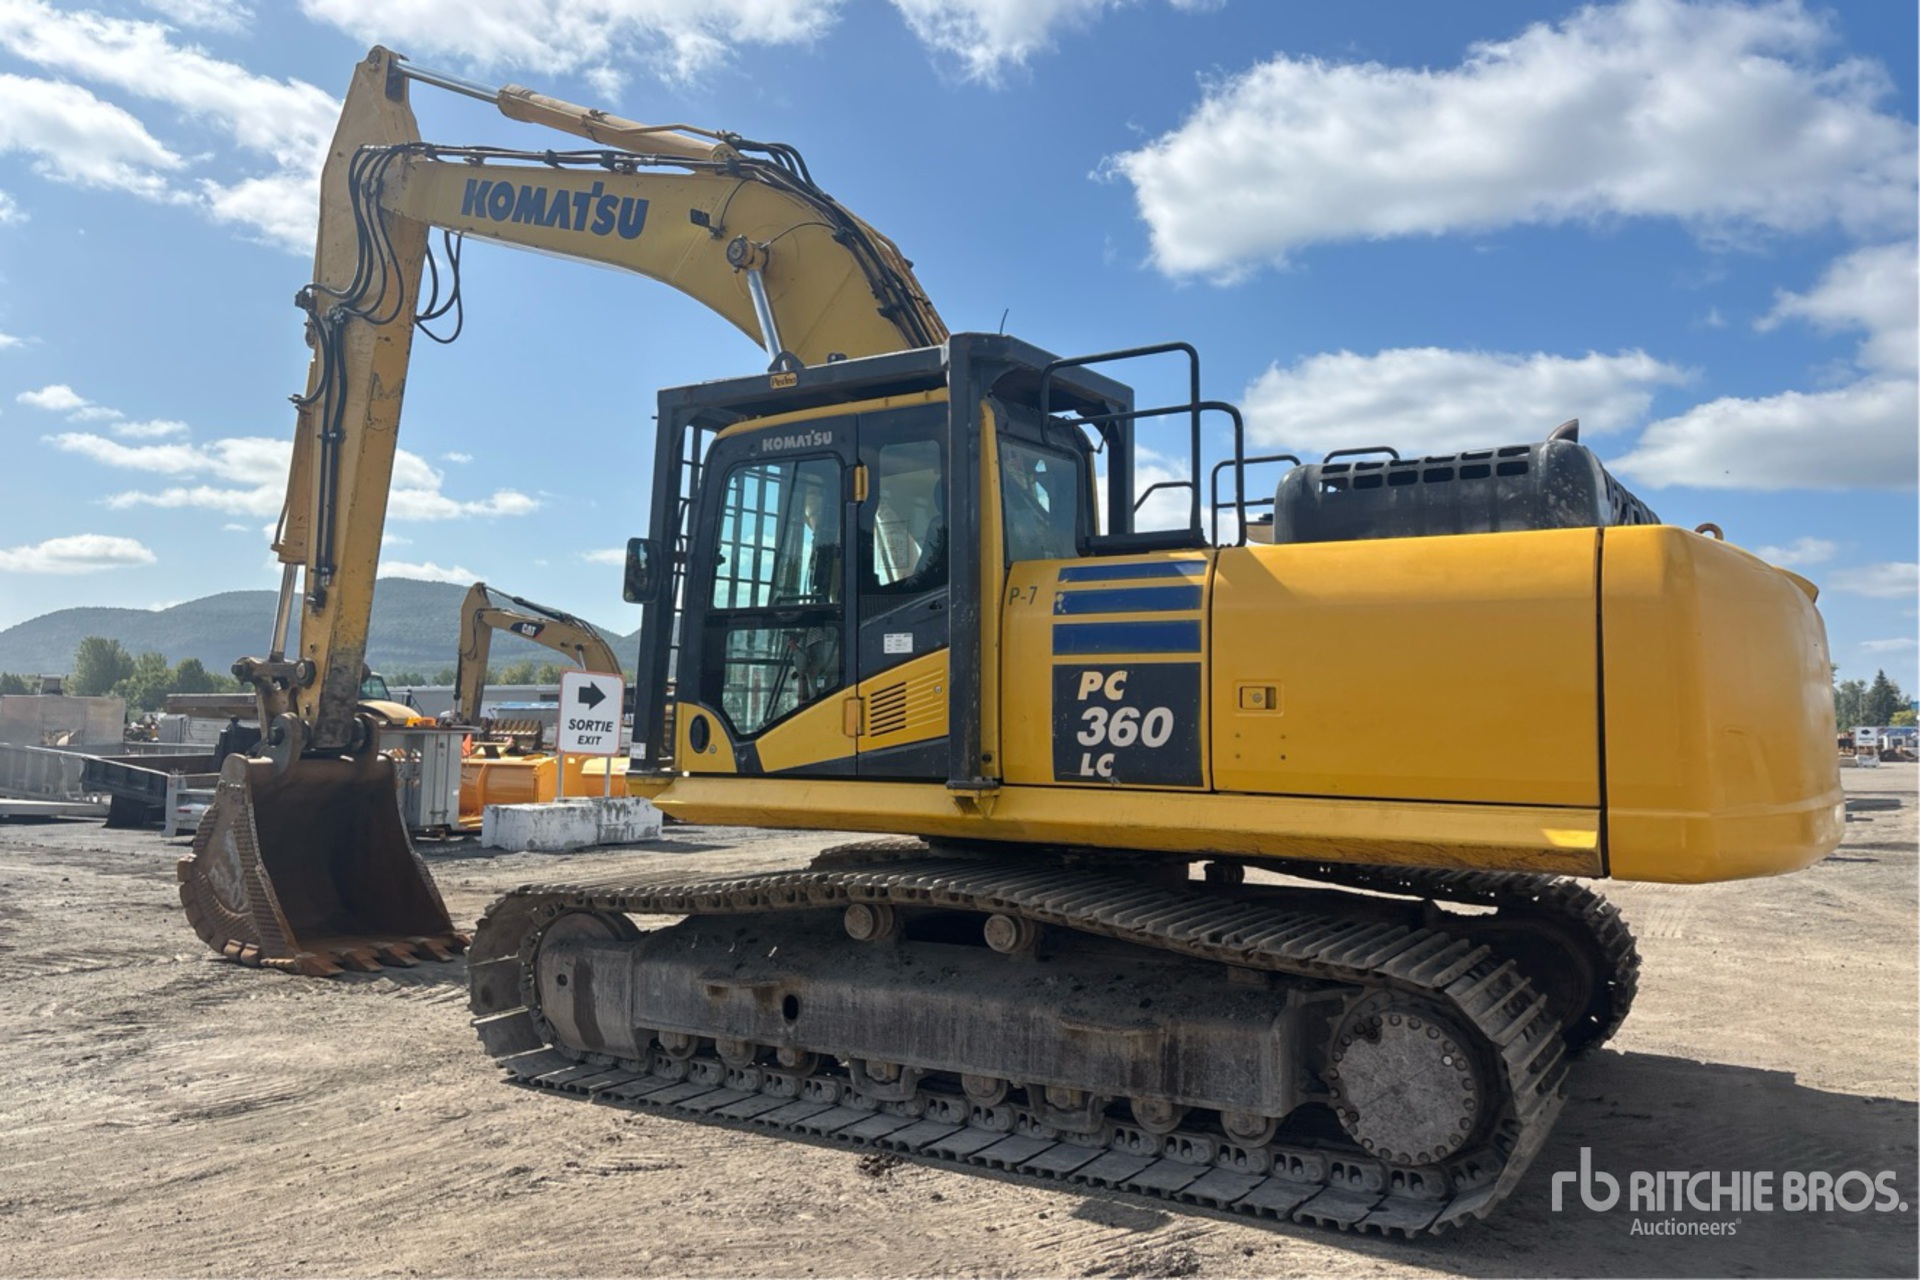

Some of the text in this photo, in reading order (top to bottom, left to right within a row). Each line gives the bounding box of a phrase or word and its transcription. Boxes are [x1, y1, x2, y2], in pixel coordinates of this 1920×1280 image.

[461, 178, 650, 240] KOMATSU
[762, 429, 833, 452] KOMATSU
[1008, 586, 1038, 606] P-7
[521, 623, 537, 637] CAT
[1077, 670, 1128, 701] PC
[568, 718, 614, 733] SORTIE
[1076, 706, 1175, 748] 360
[577, 735, 603, 746] EXIT
[1080, 752, 1115, 777] LC
